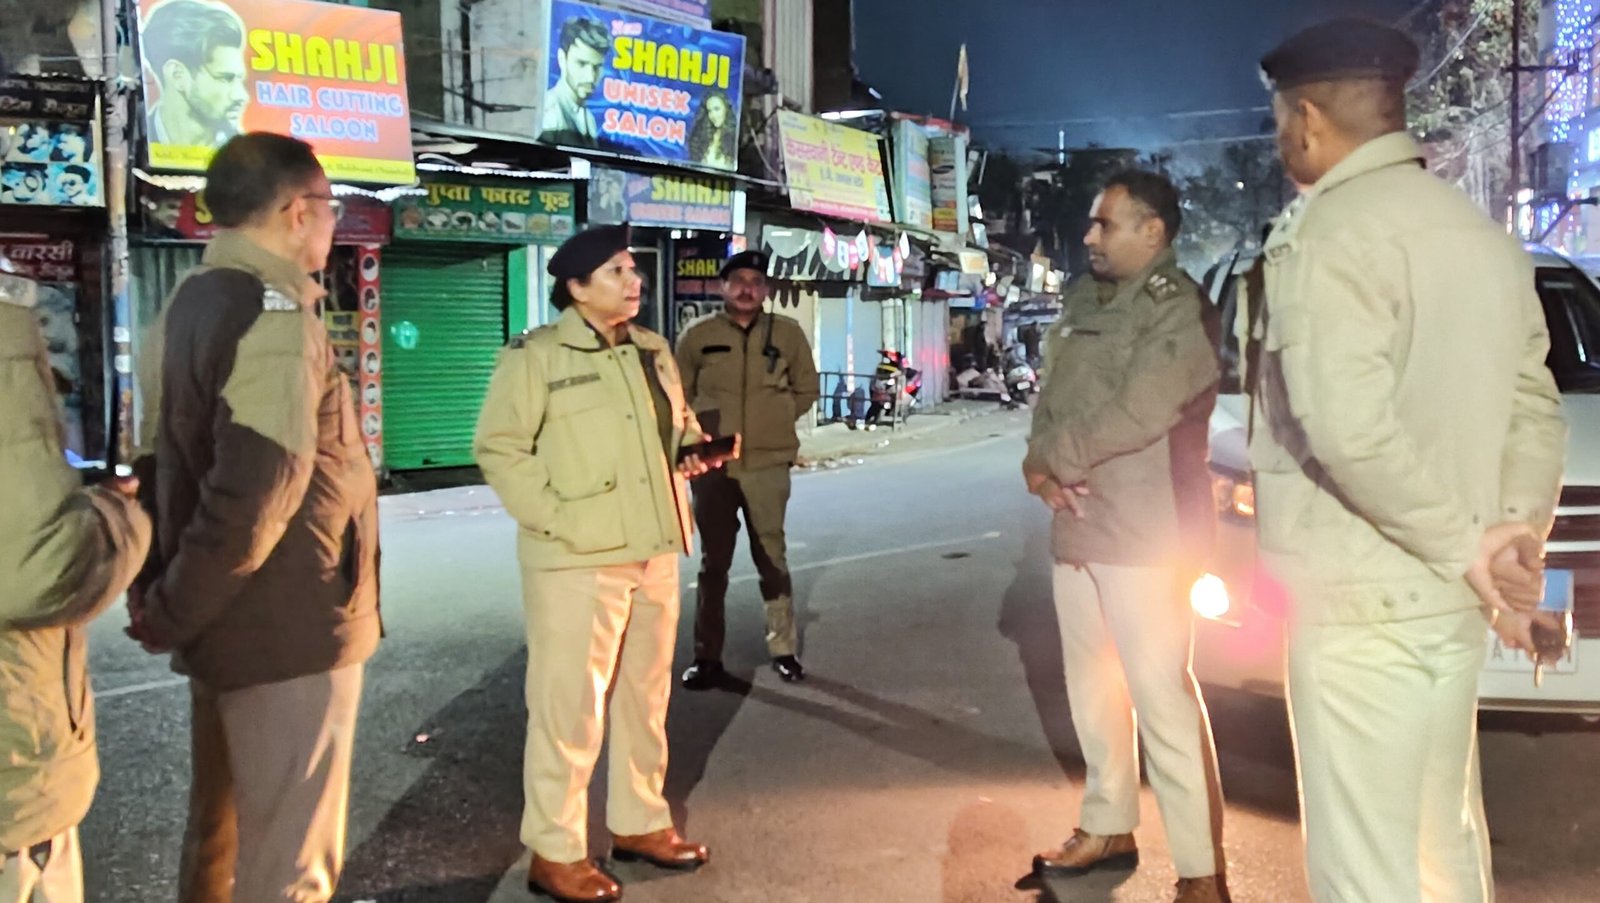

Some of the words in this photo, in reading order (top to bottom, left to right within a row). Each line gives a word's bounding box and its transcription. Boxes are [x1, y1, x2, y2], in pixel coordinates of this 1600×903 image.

[248, 29, 398, 85] SHAHJI
[613, 36, 730, 88] SHAHJI
[257, 82, 311, 107] HAIR
[318, 87, 403, 116] CUTTING
[603, 78, 691, 113] UNISEX
[291, 114, 377, 142] SALOON
[603, 110, 686, 145] SALON
[538, 191, 570, 212] फूड
[651, 174, 730, 206] SHAHJI
